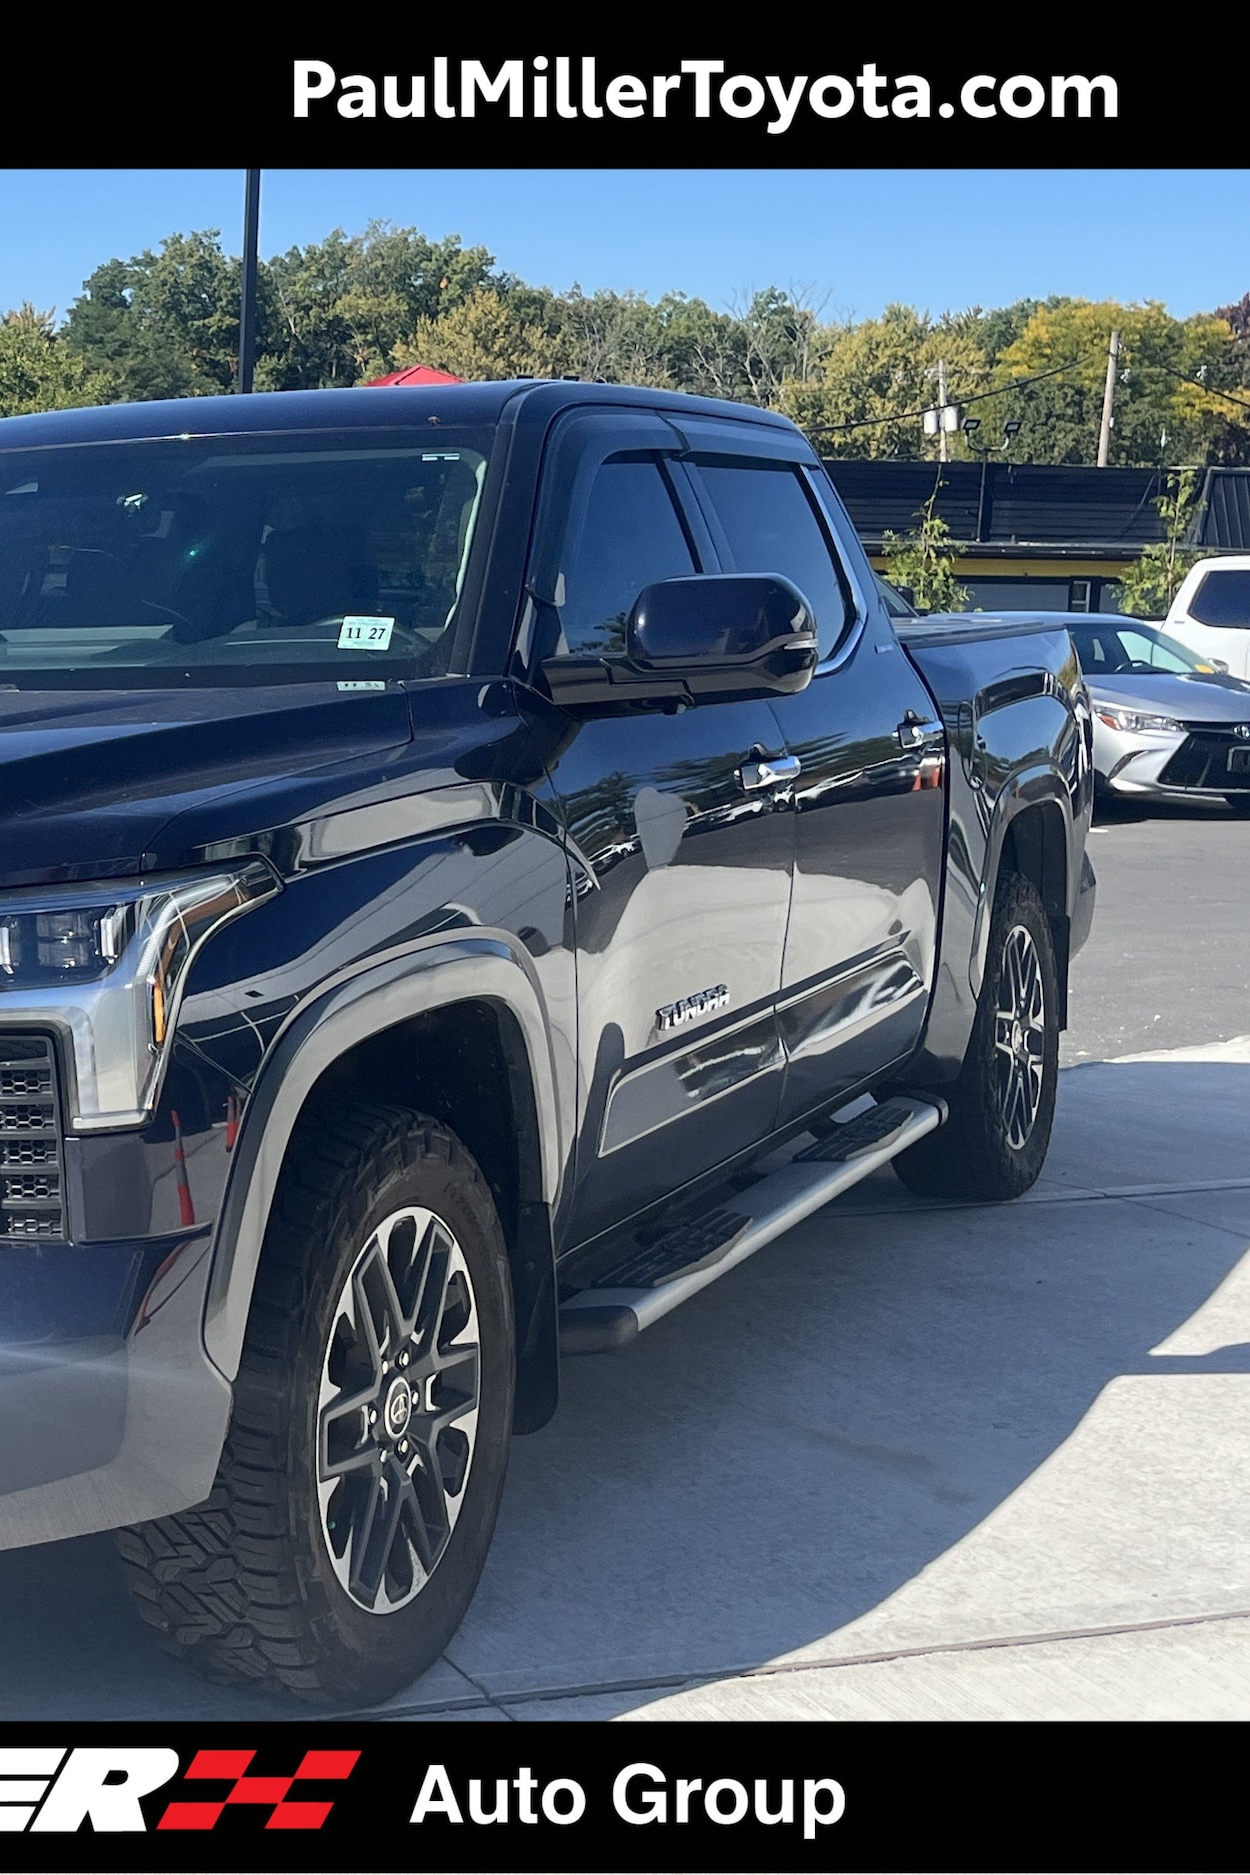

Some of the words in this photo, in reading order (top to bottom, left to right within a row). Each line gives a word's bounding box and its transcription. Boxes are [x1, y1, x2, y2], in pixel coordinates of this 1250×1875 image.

[346, 627, 362, 639] 11
[368, 627, 387, 640] 27
[655, 983, 730, 1031] TUNDRA
